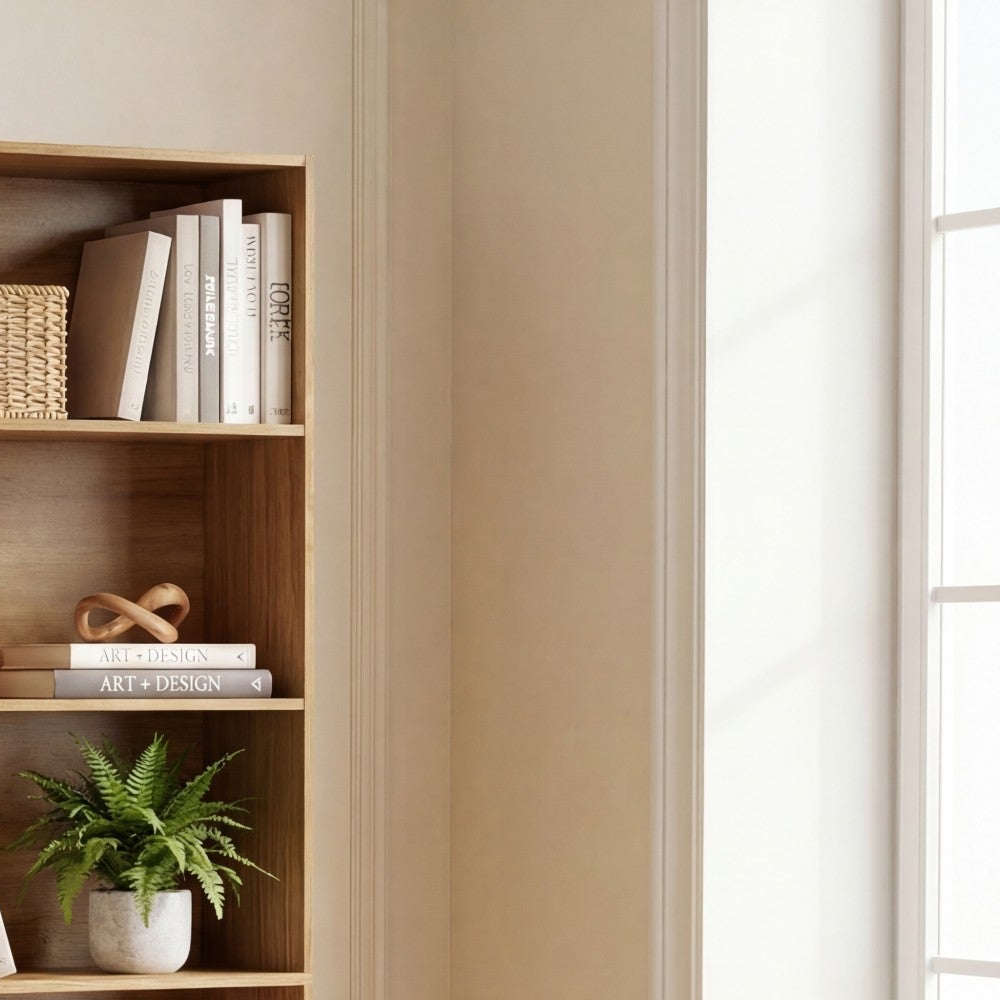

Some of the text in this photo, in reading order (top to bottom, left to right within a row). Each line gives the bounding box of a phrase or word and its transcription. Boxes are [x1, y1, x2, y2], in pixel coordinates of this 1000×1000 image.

[99, 648, 131, 663] ART
[147, 648, 209, 663] DESIGN
[99, 675, 222, 692] ART + DESIGN
